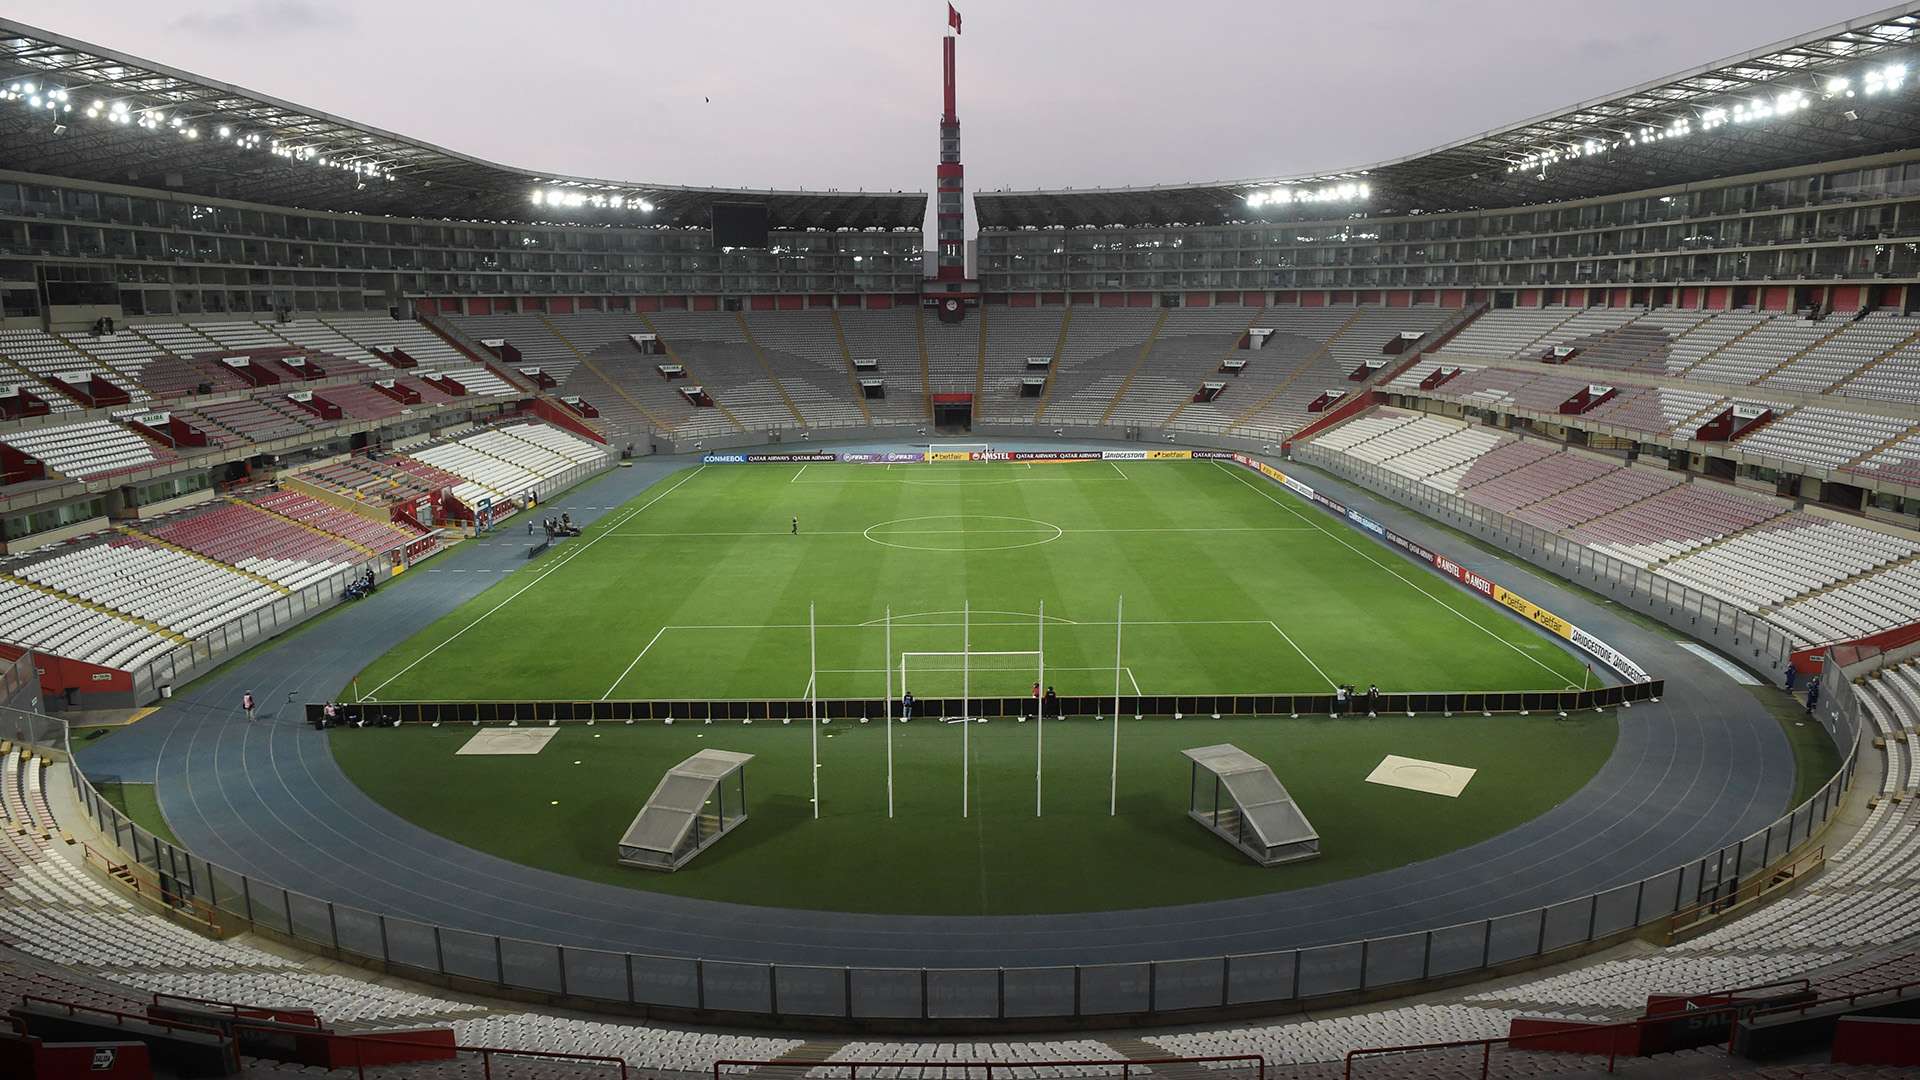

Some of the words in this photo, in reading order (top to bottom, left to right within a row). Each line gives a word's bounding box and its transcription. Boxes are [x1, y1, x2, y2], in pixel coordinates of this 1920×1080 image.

[980, 452, 1010, 460] AMSTEL
[1440, 559, 1460, 578] AMSTEL
[1470, 575, 1491, 595] AMSTEL
[1507, 596, 1527, 613] betfair
[1540, 614, 1562, 631] betfair
[1572, 630, 1612, 662] BRIDGESTONE
